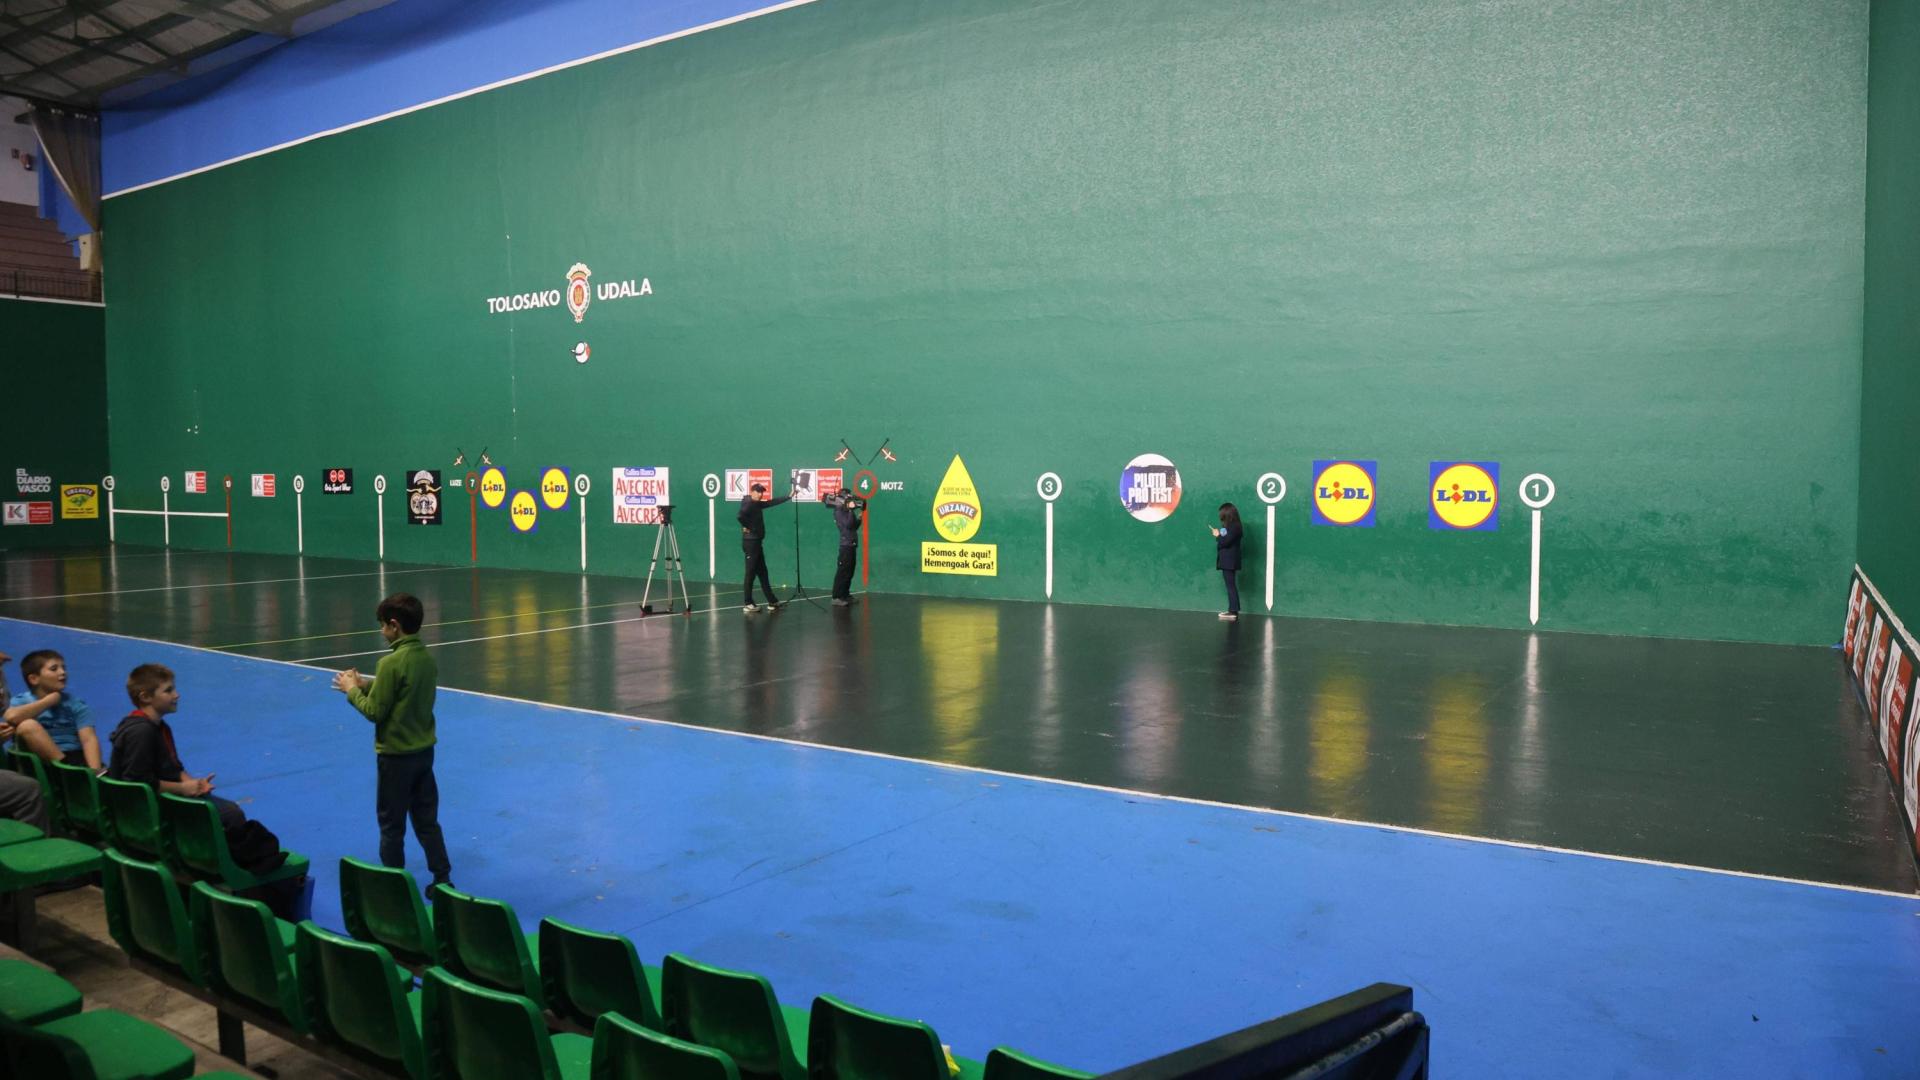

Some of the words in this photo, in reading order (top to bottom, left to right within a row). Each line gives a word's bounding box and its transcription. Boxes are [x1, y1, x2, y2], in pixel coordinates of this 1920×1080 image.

[487, 289, 561, 314] TOLOSAKO
[597, 277, 653, 301] UDALA
[16, 468, 28, 476] EL
[16, 476, 51, 484] DIARIO
[470, 479, 475, 487] 7
[579, 480, 586, 490] 6
[708, 480, 715, 490] 5
[860, 479, 869, 490] 4
[880, 481, 904, 491] MOTZ
[17, 484, 51, 493] VASCO
[615, 477, 665, 496] AVECREM
[1045, 481, 1053, 493] 3
[1267, 482, 1276, 494] 2
[1319, 481, 1369, 502] LIDL
[1532, 484, 1540, 498] 1
[1128, 487, 1149, 504] PRO
[1150, 487, 1173, 504] FEST
[1437, 484, 1491, 505] LIDL
[938, 502, 976, 517] URZANTE
[927, 547, 957, 557] ¡Somos
[958, 549, 969, 558] de
[924, 558, 970, 569] Hemengoak
[972, 560, 994, 570] Gara!
